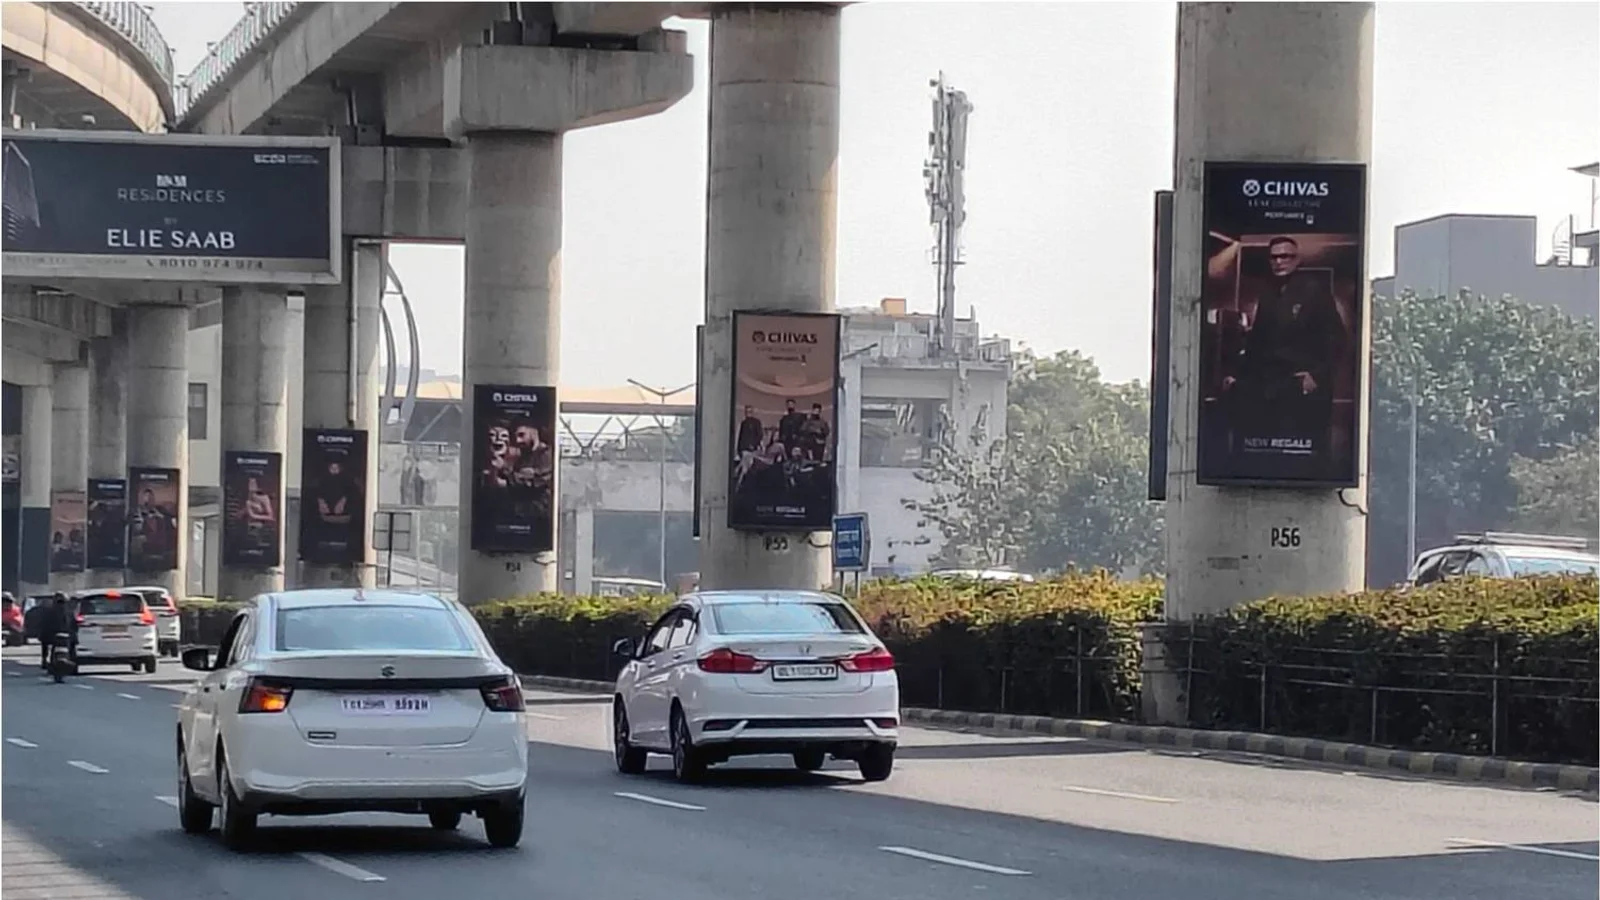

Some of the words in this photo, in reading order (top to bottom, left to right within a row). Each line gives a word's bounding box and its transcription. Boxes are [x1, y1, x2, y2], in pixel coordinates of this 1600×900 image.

[117, 187, 226, 203] RESIDENCES
[1264, 181, 1329, 196] CHIVAS
[107, 228, 163, 248] ELIE
[170, 229, 236, 250] SAAB
[767, 332, 818, 344] CHIVAS
